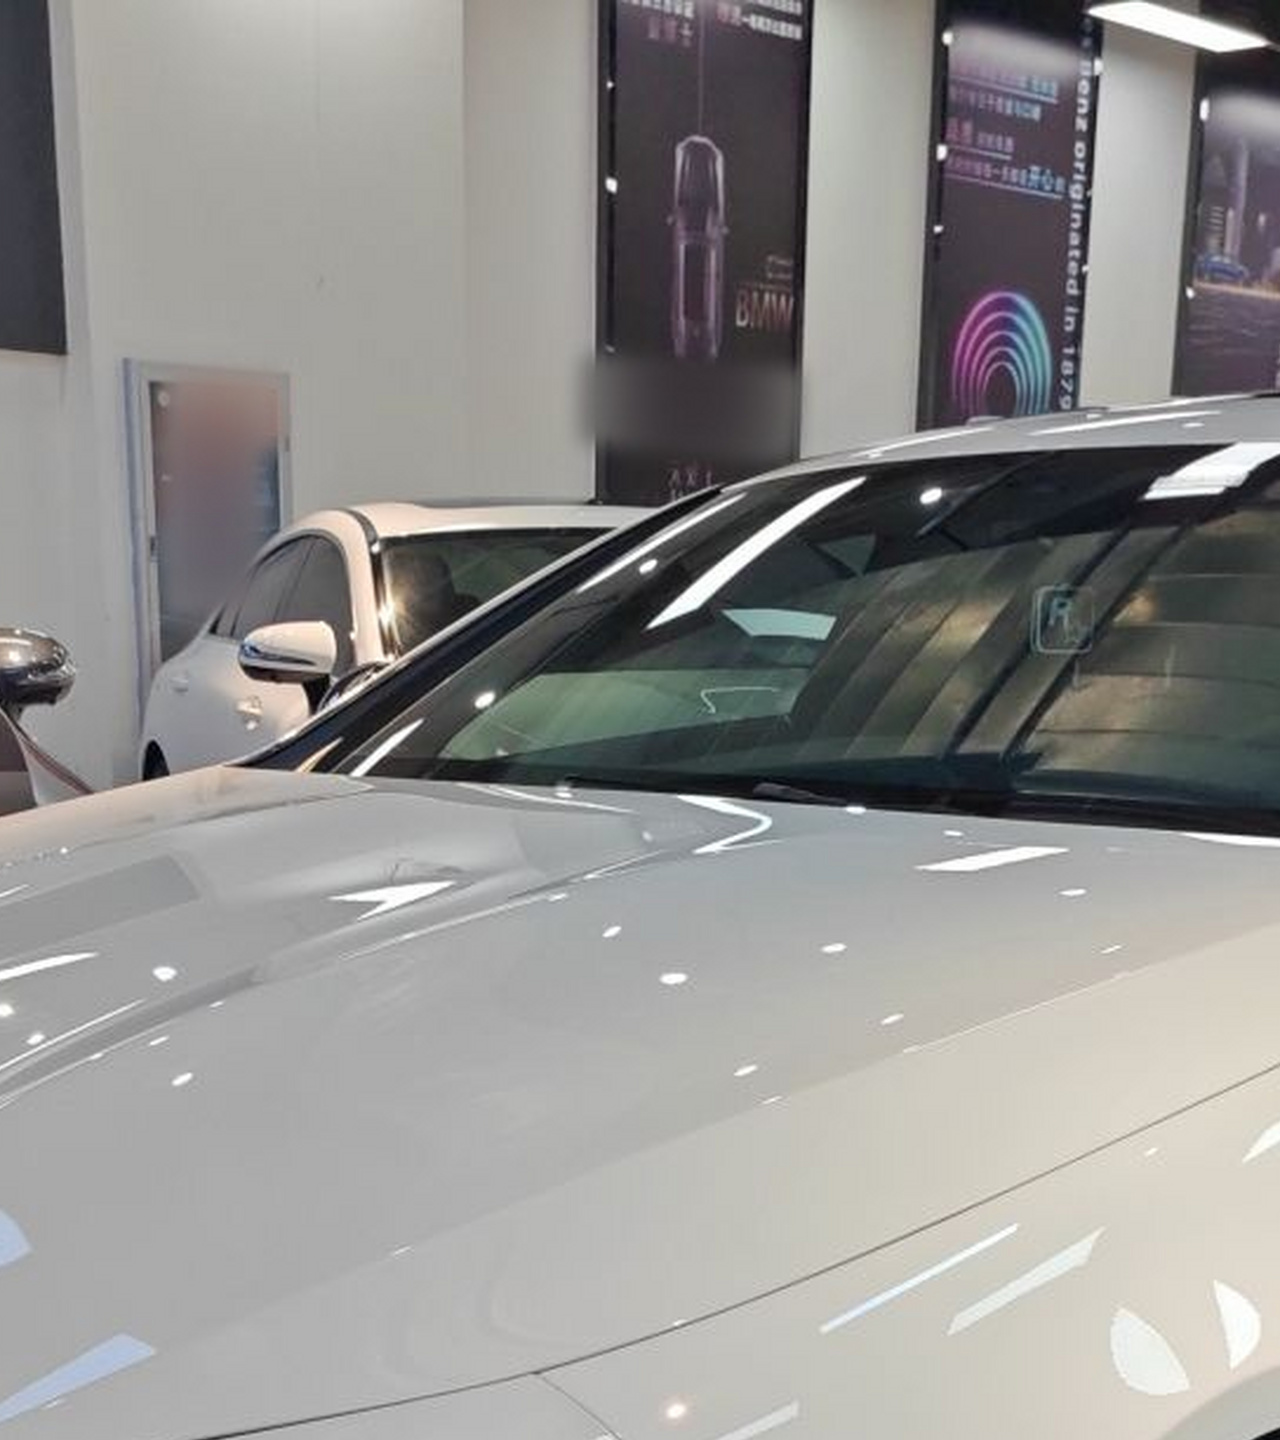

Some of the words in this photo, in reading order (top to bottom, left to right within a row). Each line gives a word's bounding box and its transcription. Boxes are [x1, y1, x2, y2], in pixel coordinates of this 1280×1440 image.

[1065, 142, 1087, 296] originated
[735, 288, 795, 331] BMW
[1064, 305, 1080, 332] in
[1058, 345, 1076, 411] 1879
